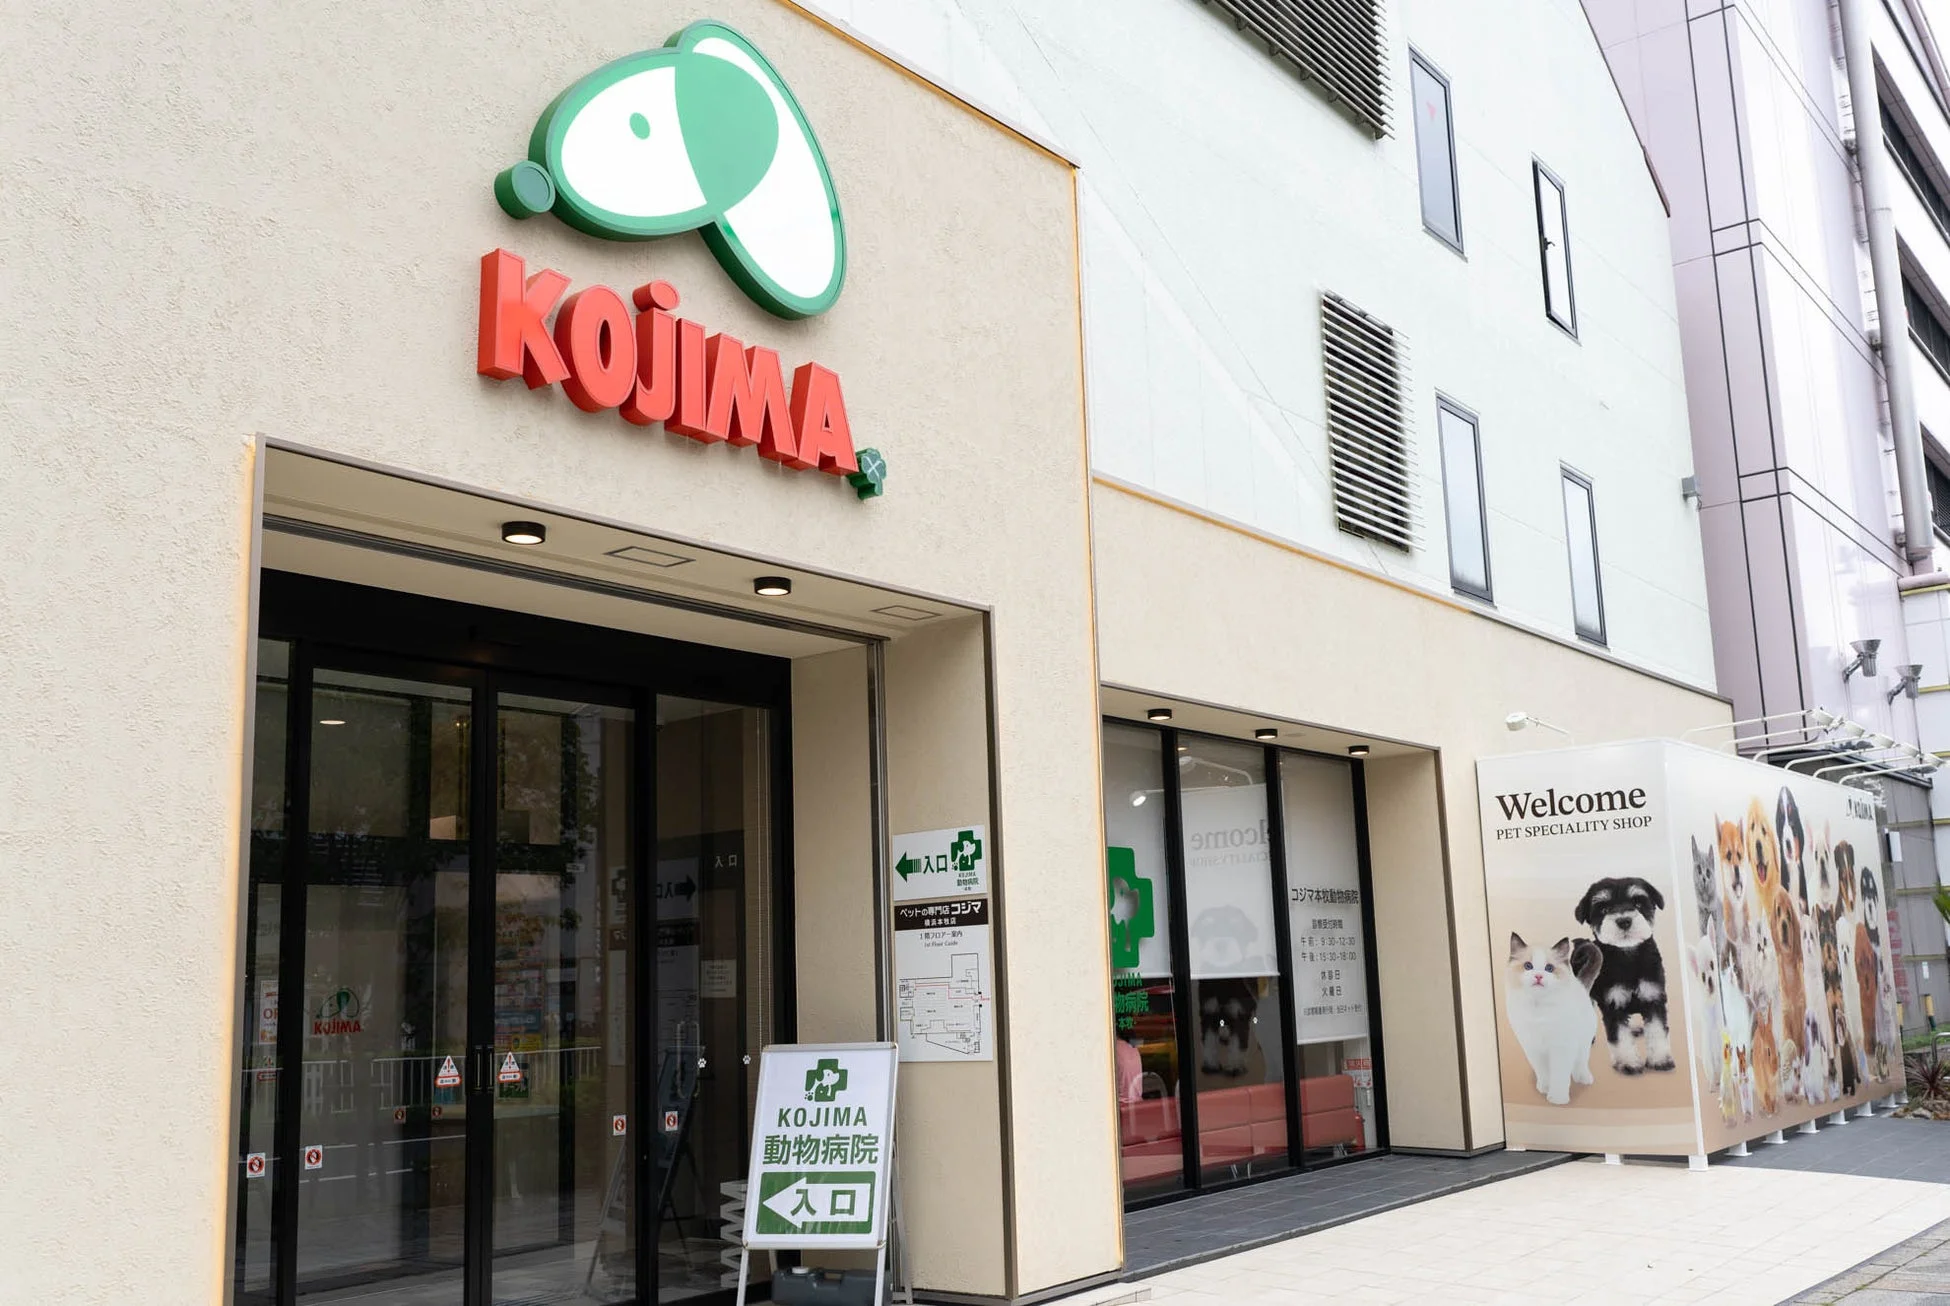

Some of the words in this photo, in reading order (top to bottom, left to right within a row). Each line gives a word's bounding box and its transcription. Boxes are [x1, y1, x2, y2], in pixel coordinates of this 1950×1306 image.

[1496, 787, 1647, 821] Welcome
[1497, 827, 1522, 840] PET
[1525, 820, 1609, 838] SPECIALITY
[1613, 815, 1652, 830] SHOP
[714, 854, 737, 868] 入口
[923, 854, 948, 874] 入口
[1291, 888, 1359, 904] コジマ本牧動物病院
[777, 1106, 868, 1127] KOJIMA
[762, 1133, 879, 1165] 動物病院
[790, 1188, 857, 1216] 入口
